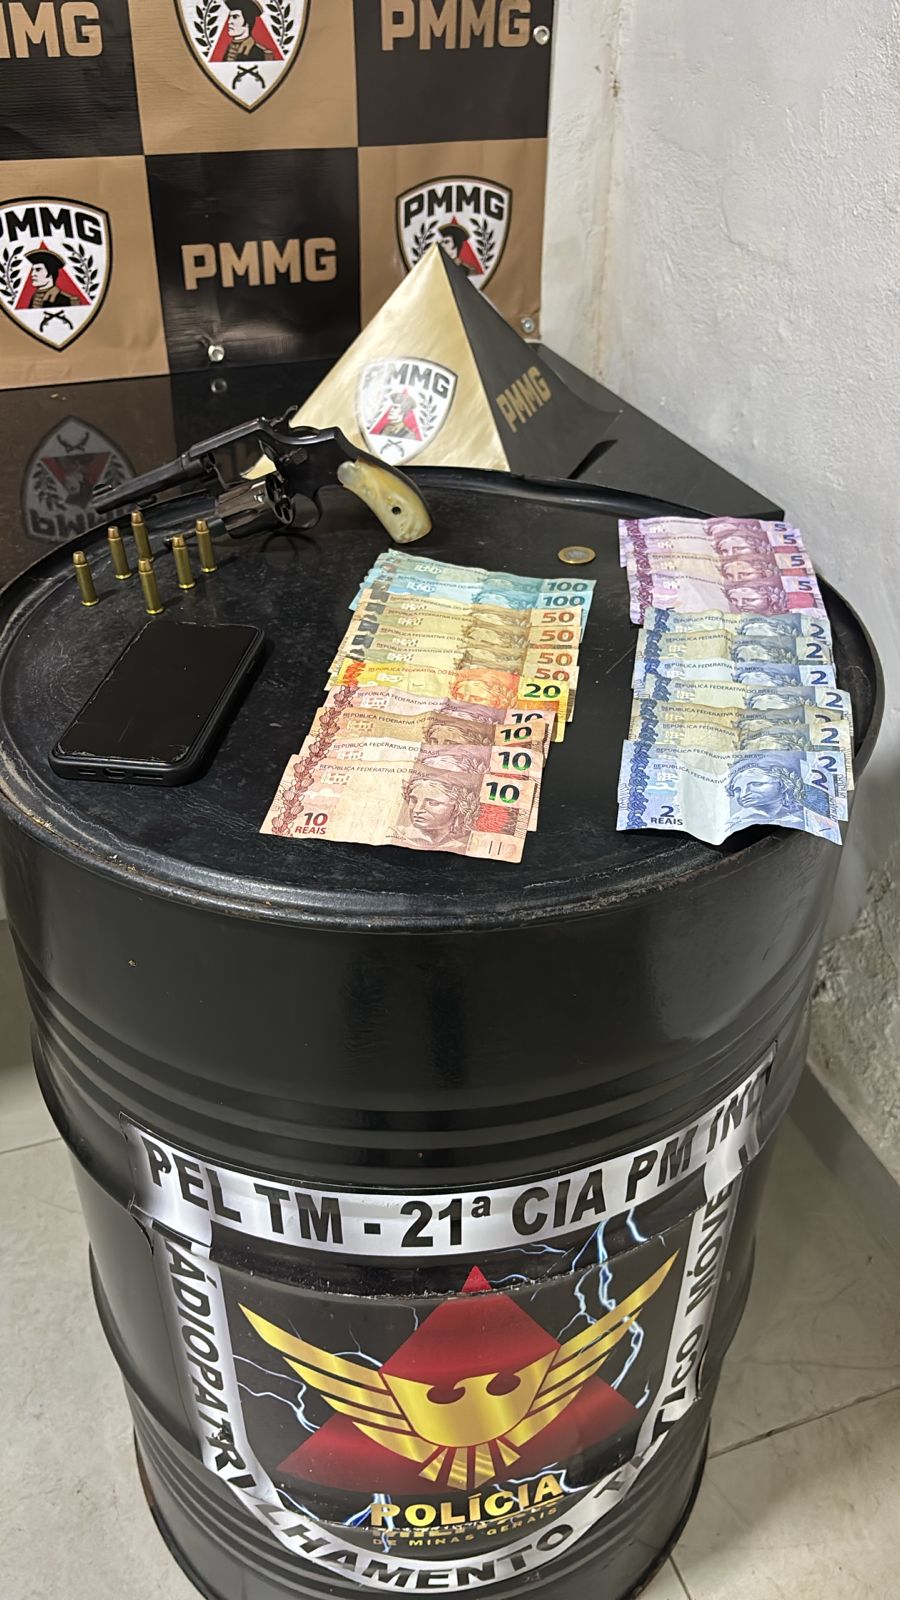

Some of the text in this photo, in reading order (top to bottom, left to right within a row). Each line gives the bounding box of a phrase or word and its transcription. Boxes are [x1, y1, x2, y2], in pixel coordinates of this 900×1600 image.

[381, 0, 531, 50] PMMG
[403, 185, 505, 227] PMMG
[0, 207, 103, 245] MMG
[181, 237, 337, 290] PMMG
[364, 362, 450, 399] MMG
[496, 366, 552, 433] PMMG
[774, 523, 787, 532] 5
[783, 534, 797, 544] 5
[790, 555, 805, 567] 5
[547, 582, 588, 592] 100
[798, 580, 813, 591] 5
[543, 596, 585, 606] 100
[541, 612, 575, 623] 50
[540, 630, 574, 642] 50
[810, 623, 826, 639] 2
[806, 643, 824, 658] 2
[537, 652, 572, 666] 50
[534, 668, 570, 681] 50
[810, 671, 829, 685] 2
[523, 684, 561, 698] 20
[825, 692, 843, 708] 2
[500, 727, 532, 742] 10
[820, 727, 840, 744] 2
[498, 752, 532, 771] 10
[818, 756, 838, 772] 2
[811, 769, 829, 790] 2
[486, 782, 520, 804] 10
[304, 812, 328, 826] 10
[660, 805, 675, 818] 2
[650, 817, 684, 826] REAIS
[295, 826, 327, 835] REAIS
[141, 1136, 242, 1223] PEL
[253, 1183, 343, 1244] TM
[363, 1223, 381, 1235] -
[399, 1196, 492, 1248] 21ª
[512, 1168, 606, 1236] CIA
[625, 1123, 699, 1203] PM
[370, 1475, 564, 1527] POLÍCIA
[373, 1538, 397, 1546] DE
[409, 1534, 475, 1547] MINAS
[487, 1507, 557, 1536] GERAIS
